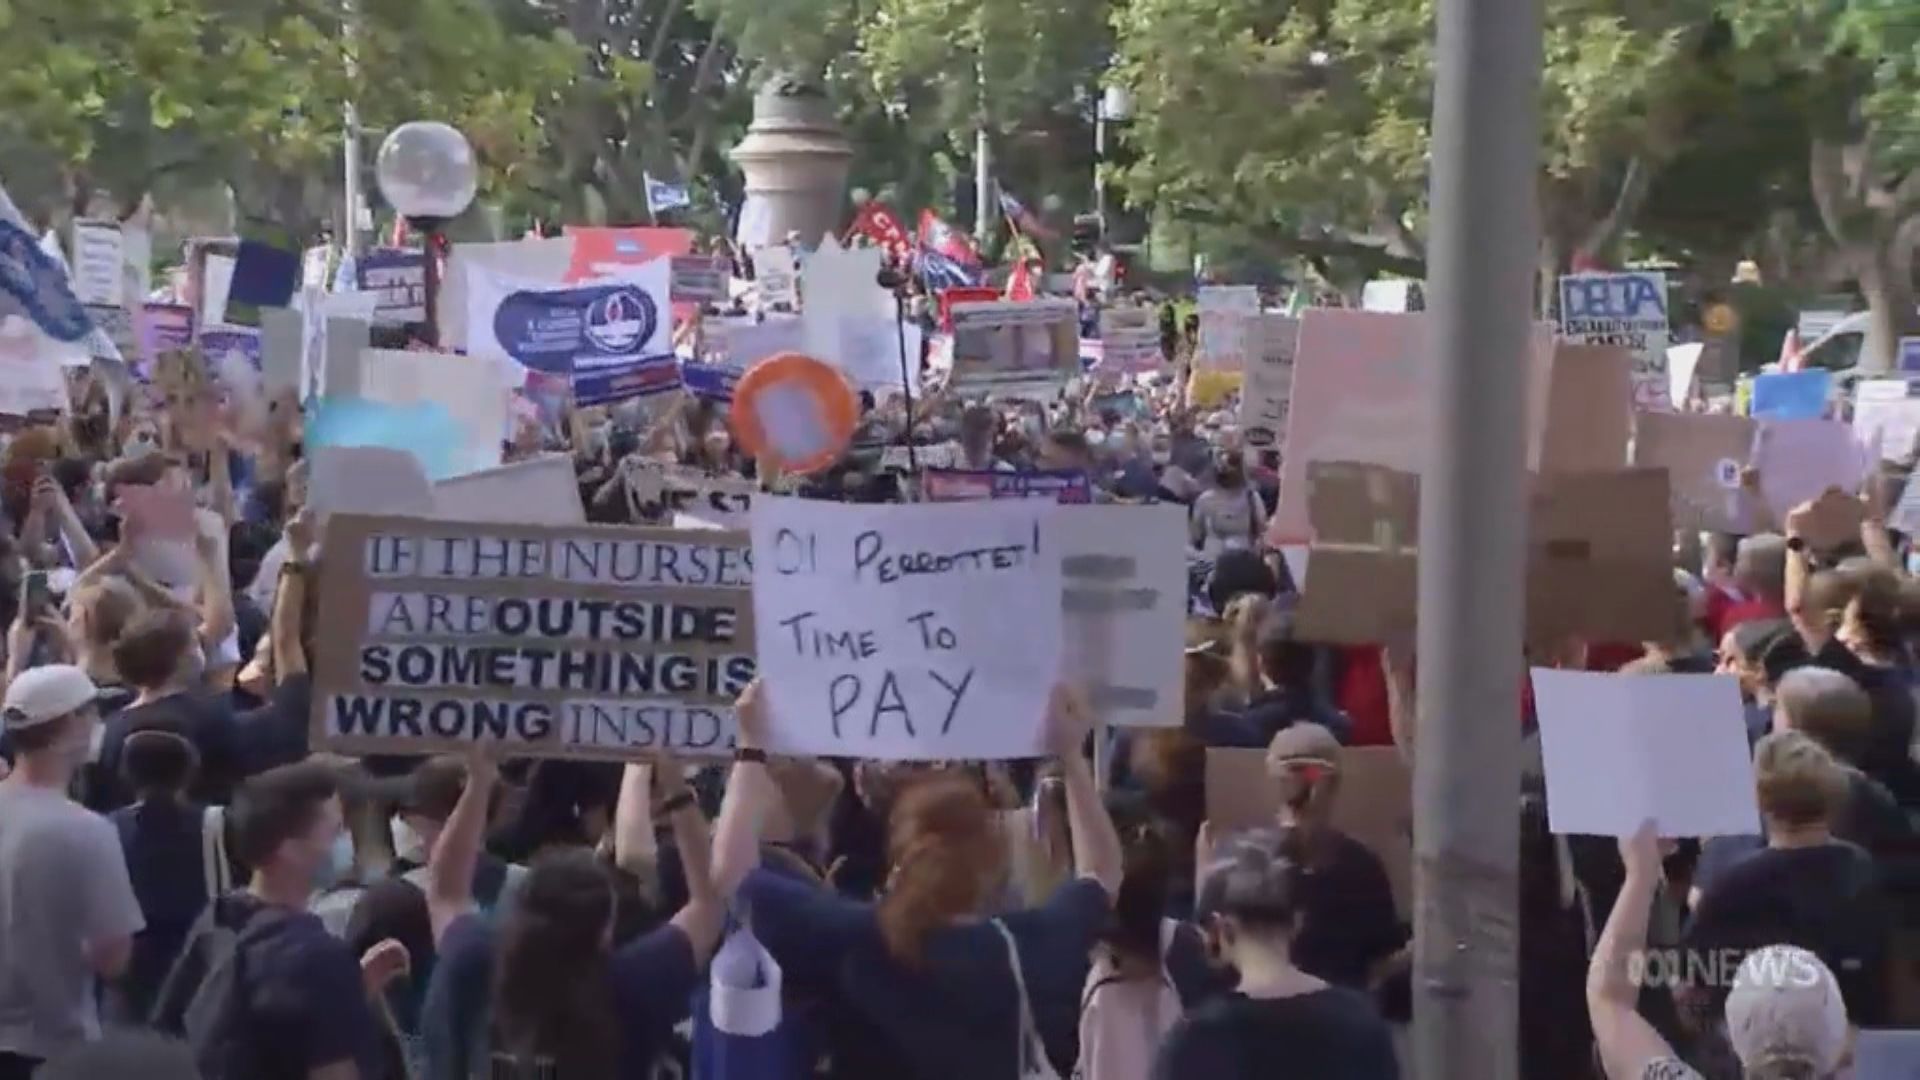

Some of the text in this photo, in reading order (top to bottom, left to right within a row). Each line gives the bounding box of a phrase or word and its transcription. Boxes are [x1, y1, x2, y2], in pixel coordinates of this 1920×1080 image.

[1563, 275, 1665, 317] DELTA
[370, 536, 412, 575] IF
[429, 537, 541, 578] THE
[776, 527, 817, 576] OI
[383, 595, 737, 642] ARE OUTSIDE
[779, 611, 957, 661] TIME TO
[361, 646, 757, 697] SOMETHING IS
[335, 697, 738, 749] WRONG INSID
[829, 668, 975, 739] PAY
